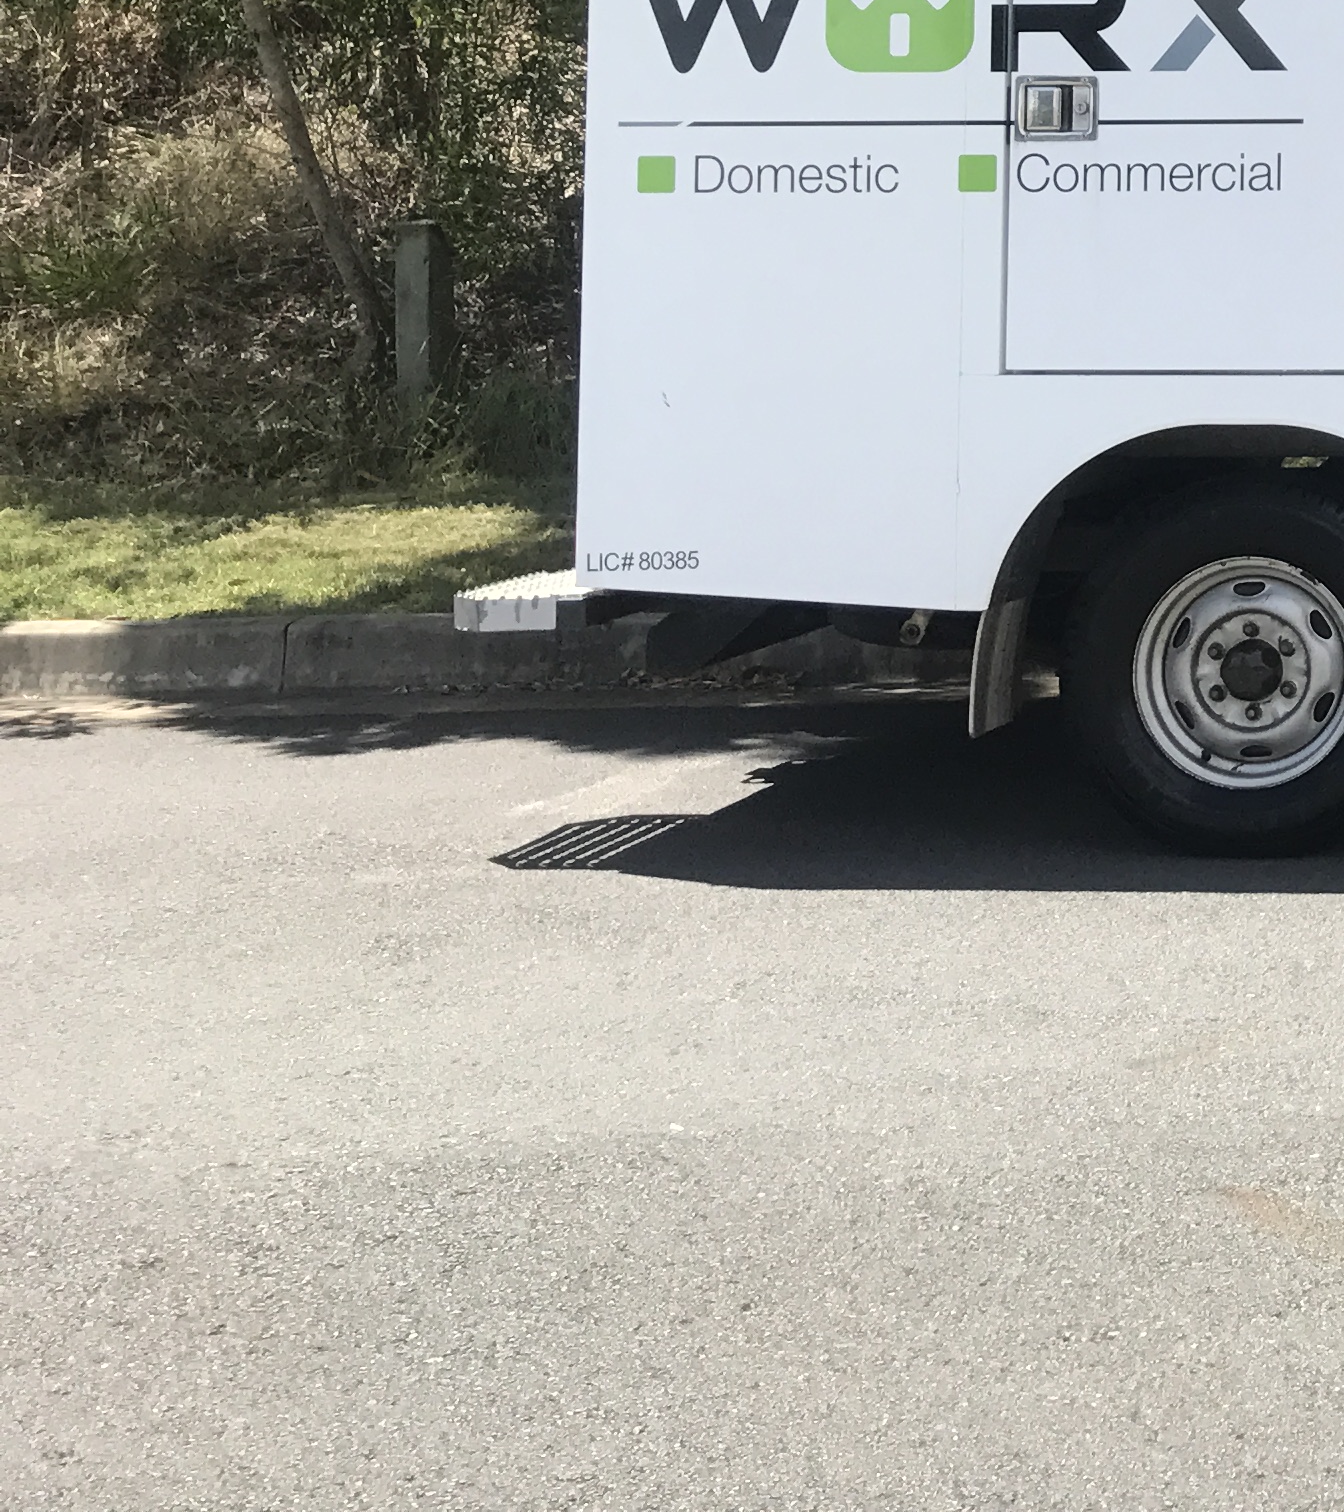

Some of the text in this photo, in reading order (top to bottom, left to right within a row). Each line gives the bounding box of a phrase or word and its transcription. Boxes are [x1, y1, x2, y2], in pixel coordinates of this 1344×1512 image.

[693, 152, 1283, 194] Domestic Commercial
[586, 550, 700, 572] LIC# 80385
